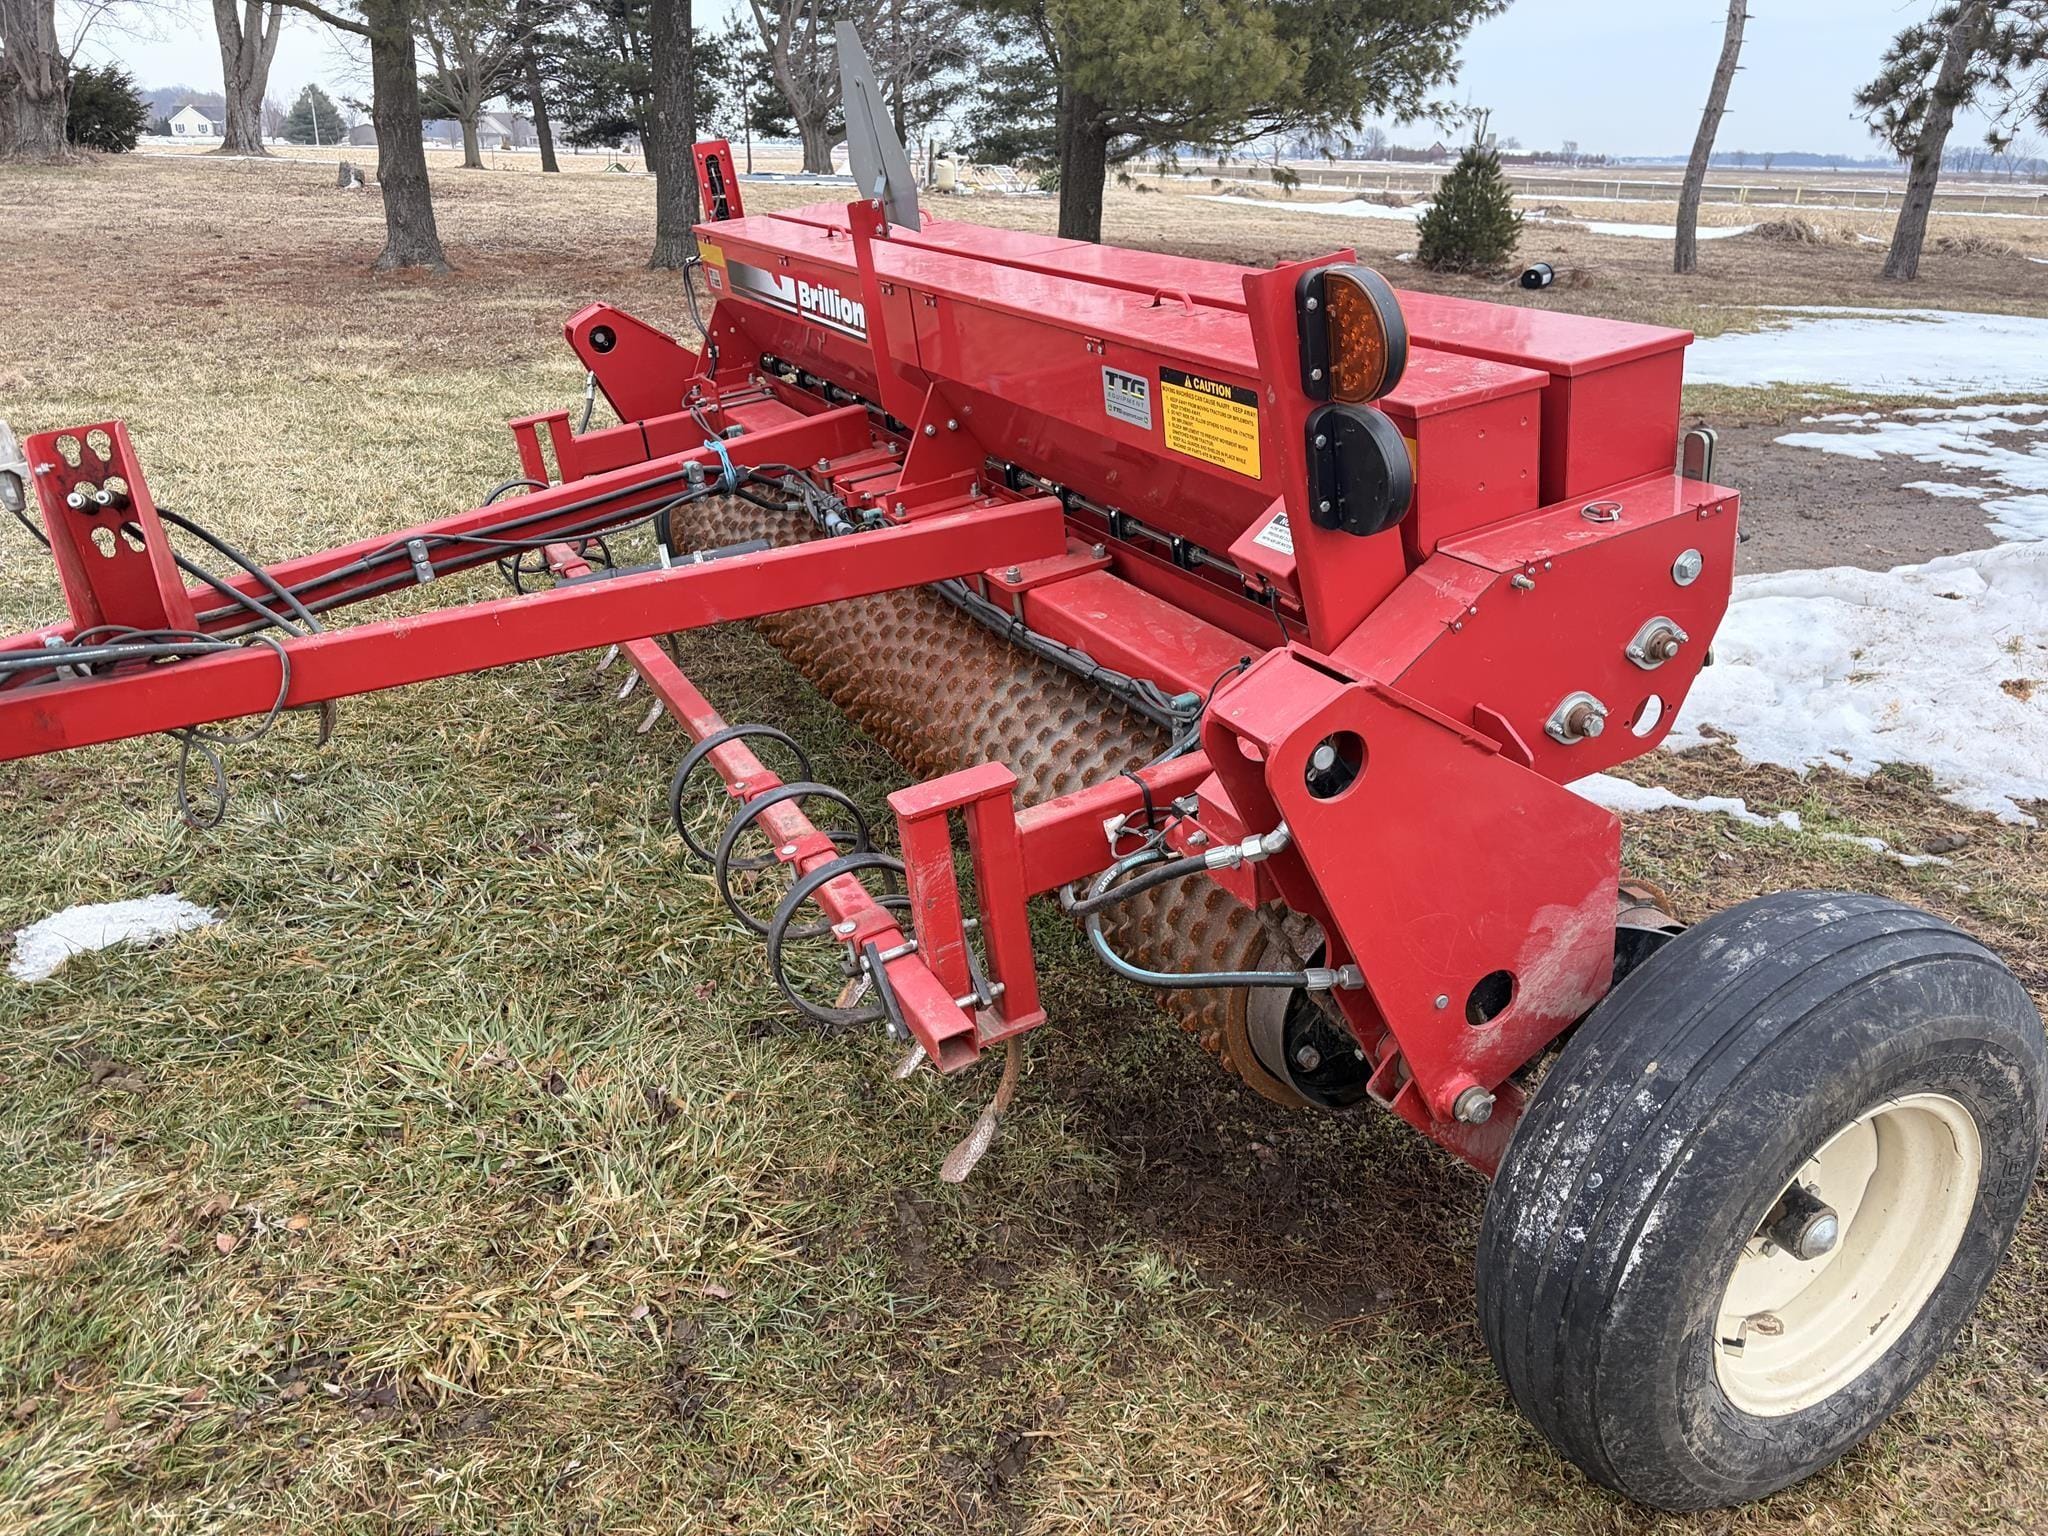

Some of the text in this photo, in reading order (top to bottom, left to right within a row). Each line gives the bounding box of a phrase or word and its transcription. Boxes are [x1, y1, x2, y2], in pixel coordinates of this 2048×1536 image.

[798, 280, 865, 328] Brillion
[1106, 371, 1145, 399] TTG
[1193, 378, 1231, 398] CAUTION
[1107, 391, 1144, 408] EQUIPMENT
[1098, 870, 1117, 892] GATES
